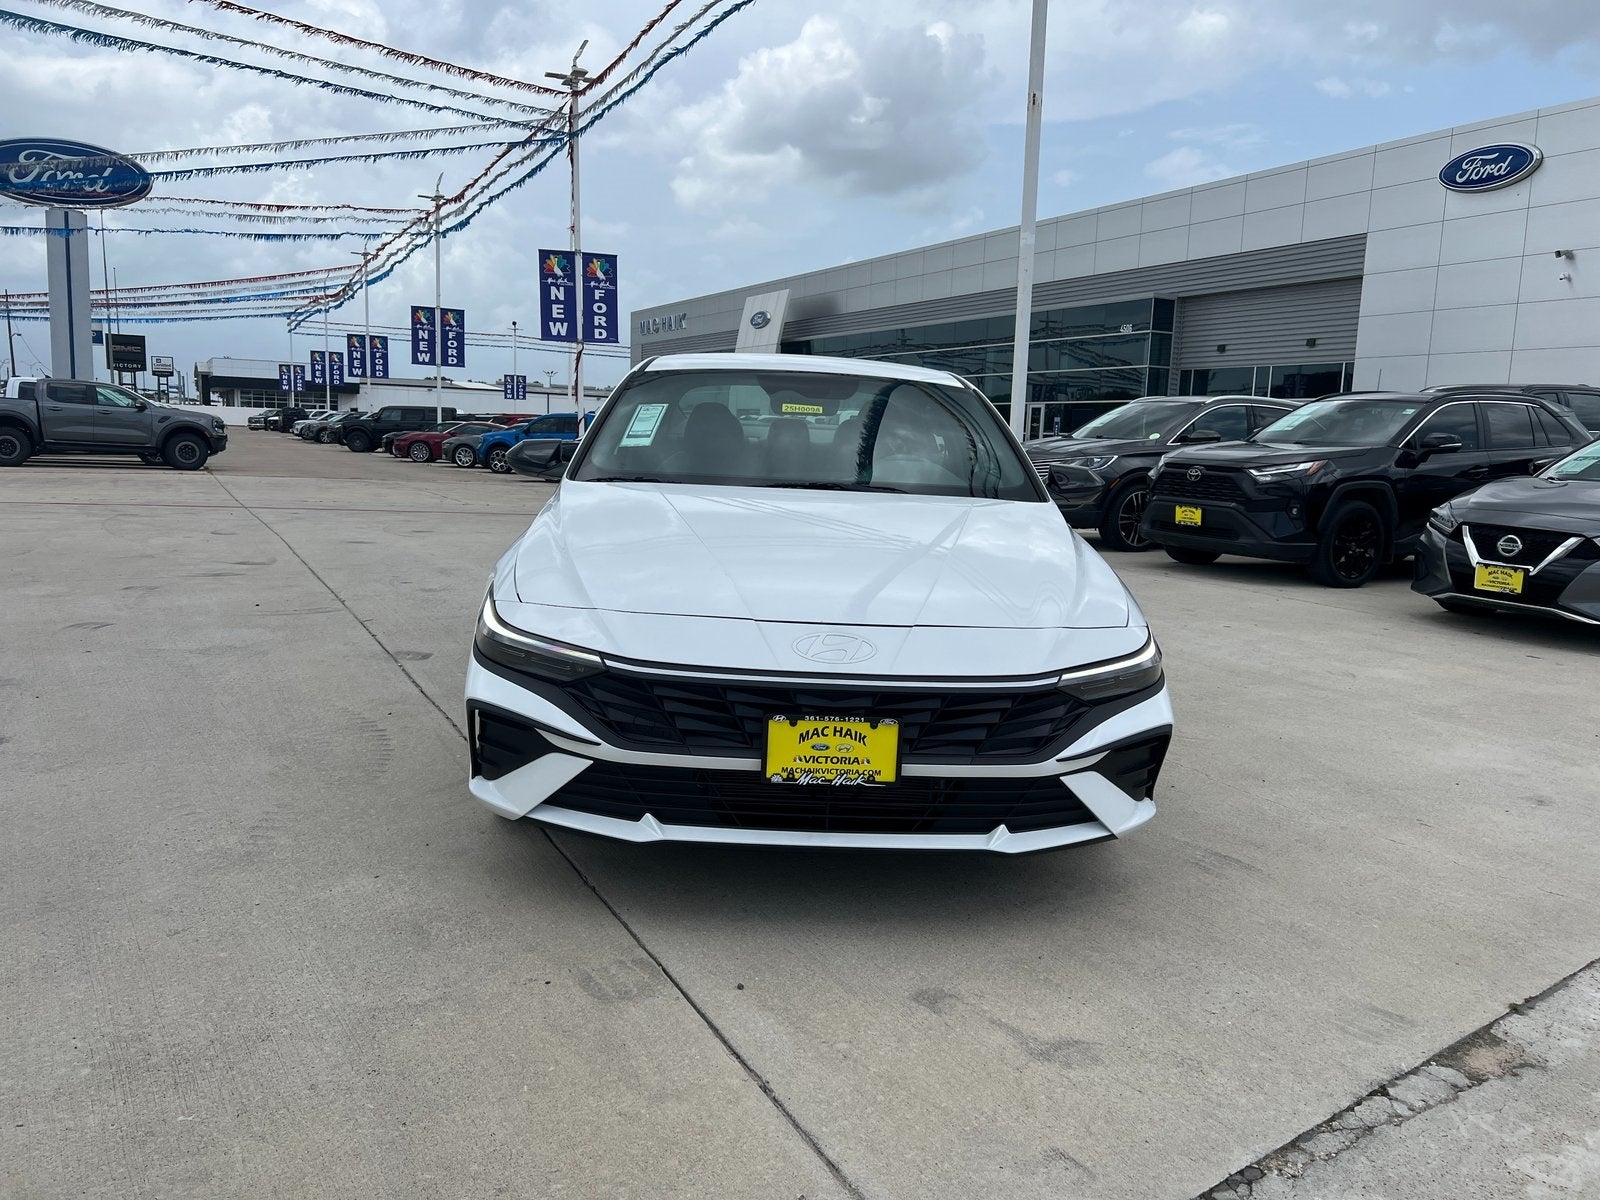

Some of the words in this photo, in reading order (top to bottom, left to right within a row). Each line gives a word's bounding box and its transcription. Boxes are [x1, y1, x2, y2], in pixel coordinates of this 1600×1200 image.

[1456, 152, 1513, 183] Ford
[548, 285, 568, 336] NEW
[592, 289, 607, 339] FORD
[639, 318, 660, 336] MAC
[661, 312, 687, 332] HAIK
[417, 329, 430, 363] NEW
[447, 331, 457, 364] FORD
[314, 364, 323, 384] NEW
[352, 351, 362, 376] NEW
[375, 352, 383, 377] FORD
[804, 715, 865, 723] 361-576-1221
[798, 725, 830, 745] MAC
[832, 725, 868, 747] HAIK
[781, 767, 882, 776] MACHAIKVICTORIA.COM
[803, 755, 861, 765] VICTORIA
[796, 772, 826, 786] Mac
[831, 773, 868, 786] Haik
